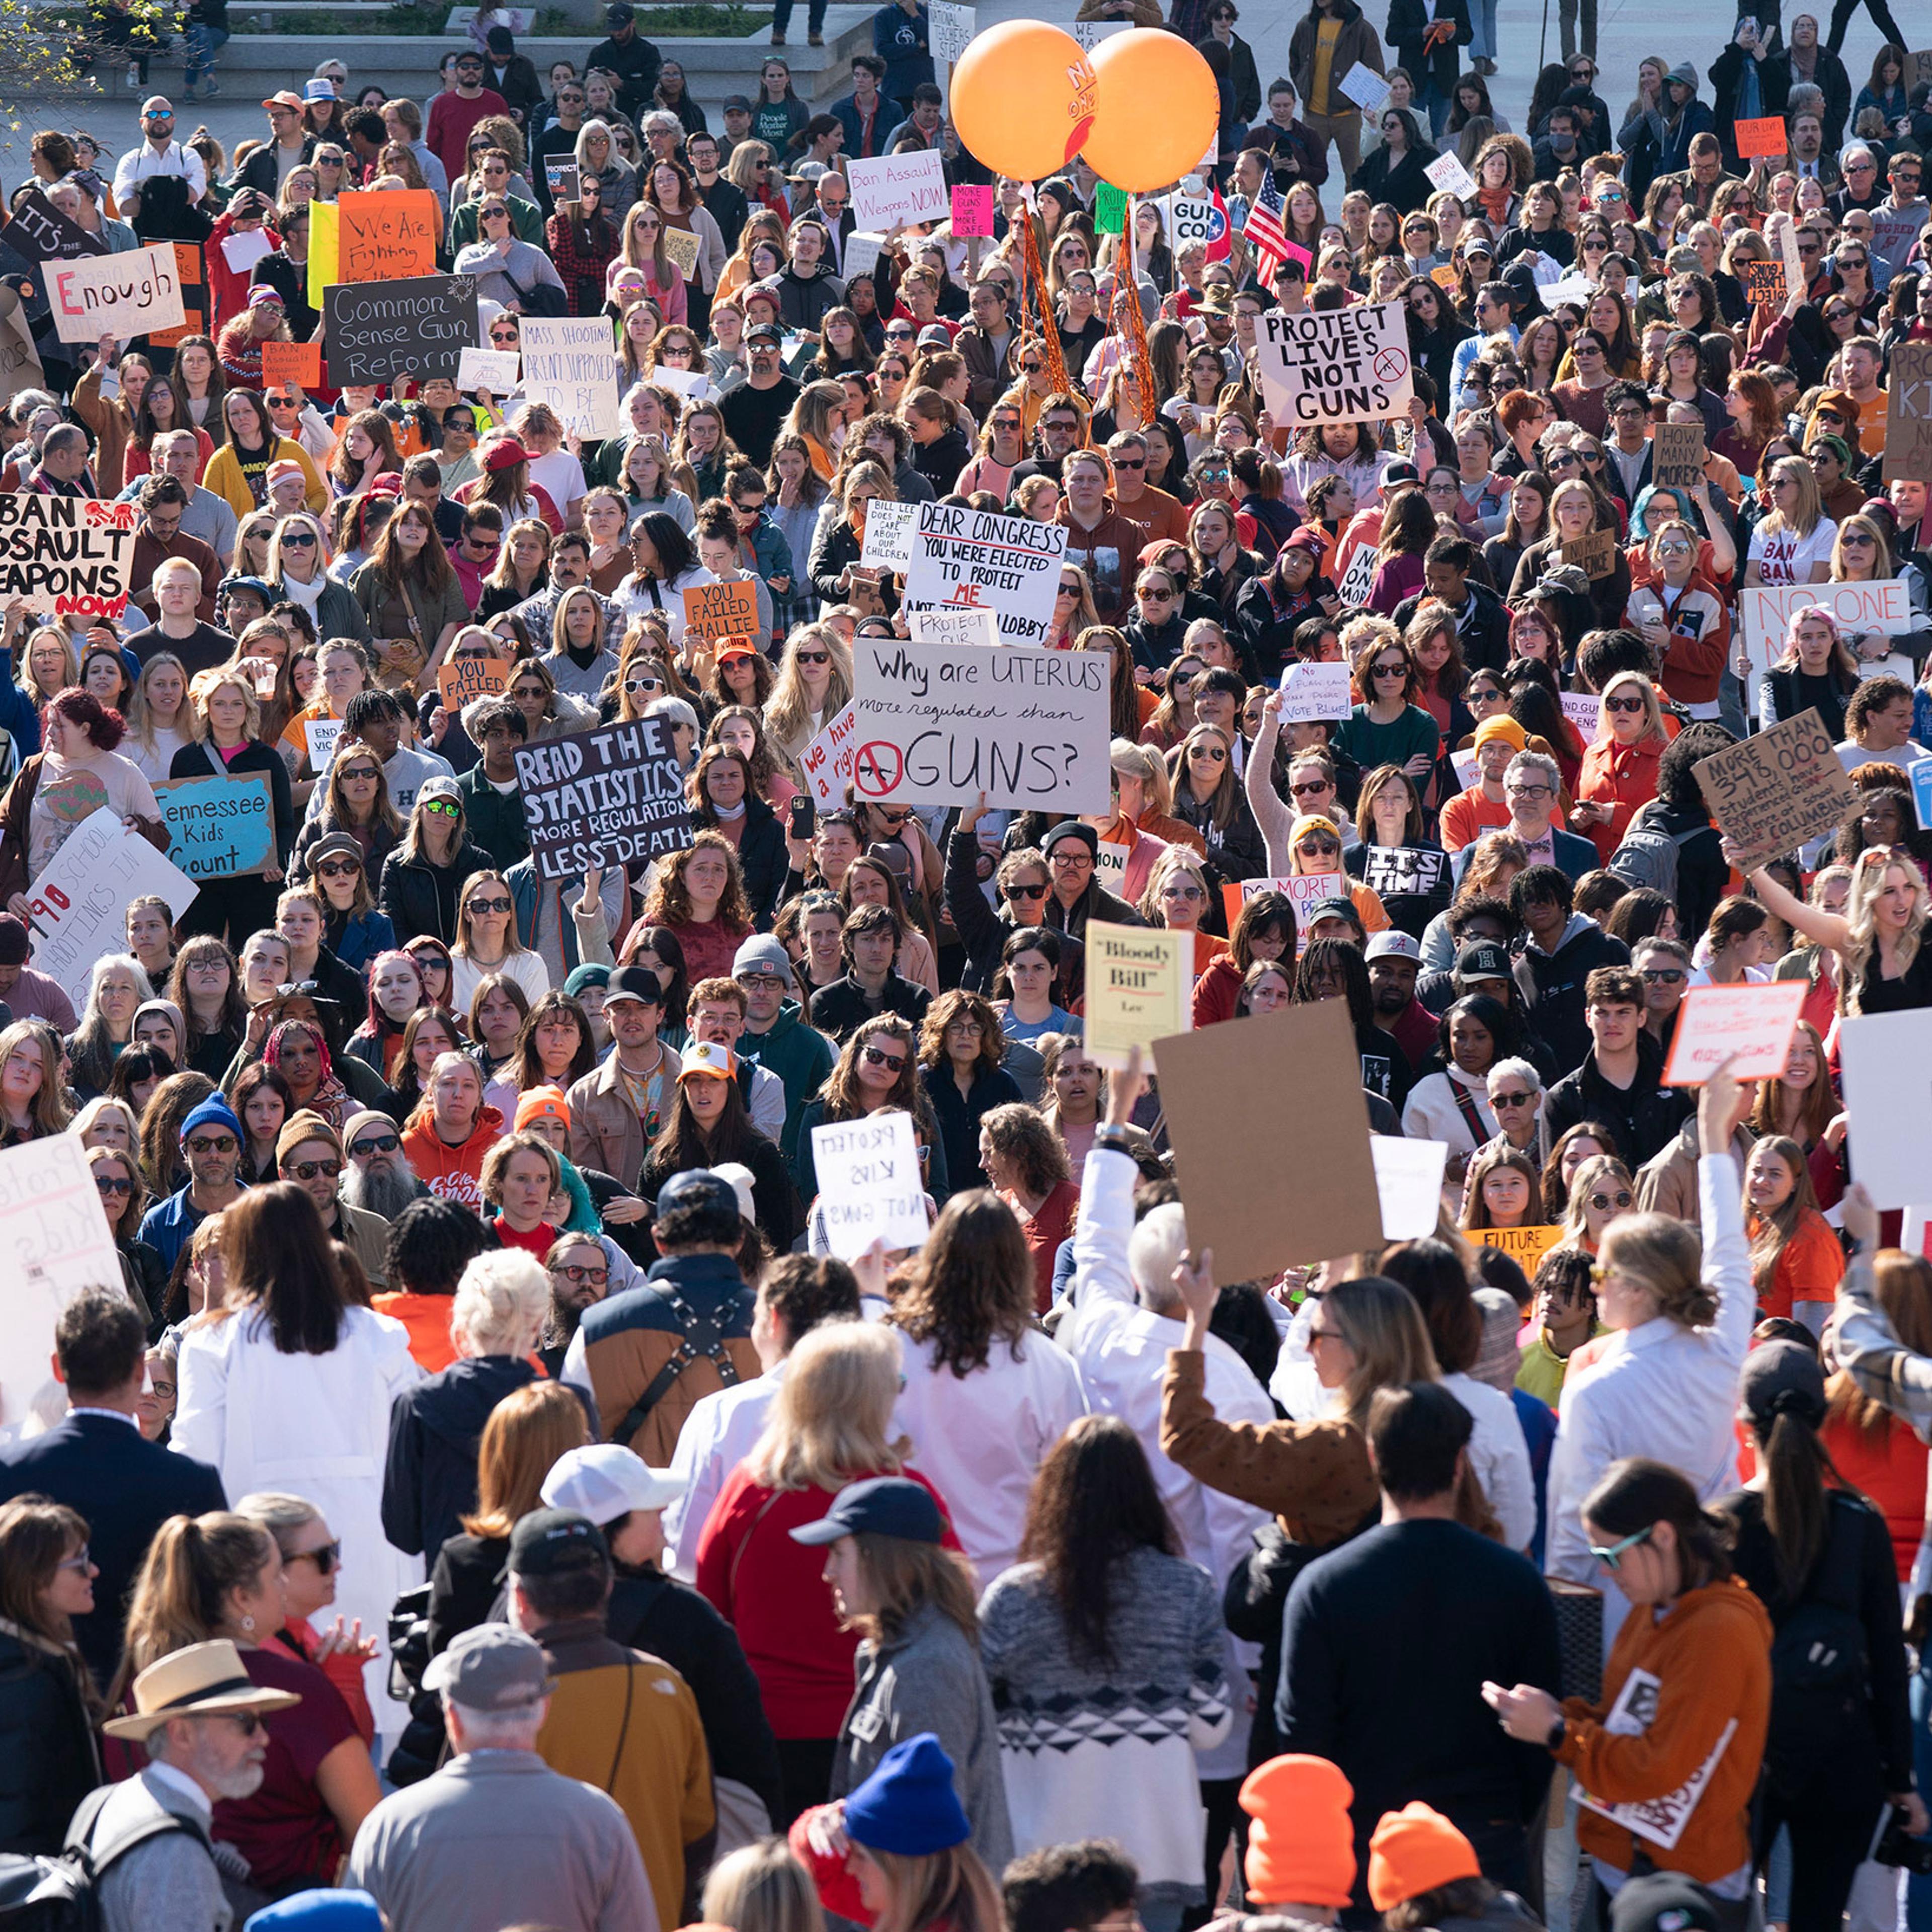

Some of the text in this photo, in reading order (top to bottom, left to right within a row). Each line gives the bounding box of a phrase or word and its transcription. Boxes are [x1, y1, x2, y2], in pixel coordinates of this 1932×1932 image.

[1076, 23, 1094, 35] WE
[851, 158, 940, 189] Ban Assault
[856, 184, 944, 220] Weapons NOW
[956, 187, 982, 197] MORE
[346, 205, 430, 239] We Are
[955, 216, 977, 224] MORE
[961, 225, 983, 235] SAFE
[349, 243, 418, 271] Fighting
[56, 253, 172, 316] Enough
[334, 288, 451, 324] Common
[339, 315, 471, 349] Sense Gun
[525, 326, 554, 345] MASS
[1266, 305, 1387, 343] PROTECT
[1280, 333, 1380, 367] LIVES
[564, 352, 615, 383] SUPPOSED
[1301, 360, 1364, 391] NOT
[545, 386, 565, 409] TO
[577, 386, 598, 412] BE
[1295, 383, 1391, 420] GUNS
[1663, 428, 1696, 444] HOW
[1661, 446, 1697, 462] MANY
[1656, 464, 1700, 486] MORE?
[871, 511, 912, 522] DOES NOT
[874, 500, 915, 514] BILL LEE
[873, 529, 902, 540] ABOUT
[879, 521, 900, 530] CARE
[920, 503, 1064, 555] DEAR CONGRESS
[865, 545, 909, 561] CHILDREN
[878, 539, 896, 549] OUR
[924, 536, 1049, 573] YOU WERE ELECTED
[1763, 541, 1797, 561] BAN
[939, 562, 1025, 591] TO PROTECT
[1761, 562, 1796, 581] BAN
[55, 591, 129, 619] NOW!
[702, 584, 733, 604] YOU
[955, 584, 983, 605] ME
[1833, 585, 1904, 624] ONE
[692, 598, 750, 621] FAILED
[692, 616, 755, 638] HALLIE
[919, 614, 986, 633] PROTECT
[1001, 614, 1048, 641] LOBBY
[455, 661, 486, 680] YOU
[872, 648, 930, 697] Why
[939, 661, 978, 683] are
[446, 677, 505, 697] FAILED
[859, 698, 1084, 725] more regulated than
[1284, 697, 1349, 718] VOTE BLUE!
[315, 728, 338, 737] END
[828, 711, 855, 747] have
[514, 719, 667, 791] READ THE
[1707, 712, 1819, 781] MORE THAN
[904, 730, 1080, 794] GUNS?
[1787, 762, 1822, 783] have
[523, 758, 683, 824] STATISTICS
[818, 778, 830, 797] a
[530, 798, 690, 845] MORE REGULATION
[1769, 790, 1855, 840] COLUMBINE
[184, 821, 225, 844] Kids
[57, 825, 115, 891] SCHOOL
[169, 844, 240, 880] Count
[540, 825, 695, 879] LESS DEATH
[1368, 847, 1438, 874] IT'S
[1277, 876, 1332, 900] MORE
[1477, 949, 1497, 970] H
[1484, 1230, 1543, 1250] FUTURE
